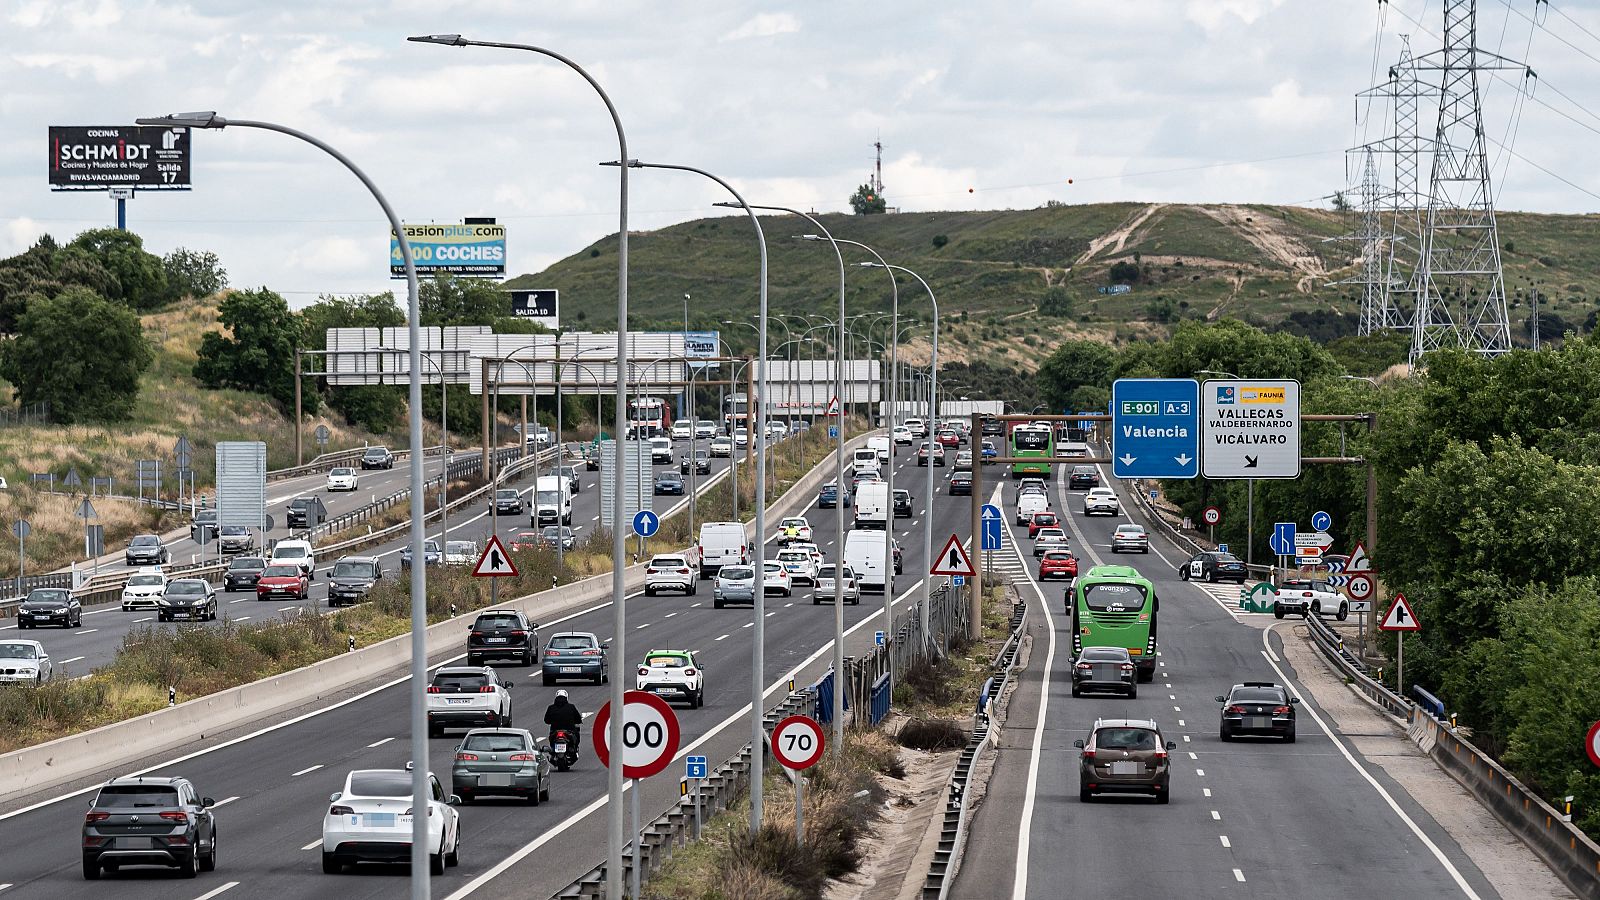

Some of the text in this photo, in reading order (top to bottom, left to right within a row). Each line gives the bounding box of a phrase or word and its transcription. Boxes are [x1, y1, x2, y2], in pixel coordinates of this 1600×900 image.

[87, 129, 119, 138] COCINAS
[61, 161, 85, 169] Cocinas
[93, 161, 118, 169] Muebles
[120, 161, 127, 169] de
[129, 161, 149, 170] Hogar
[157, 164, 182, 172] Salida
[161, 172, 177, 183] 17
[392, 246, 503, 261] 400 COCHES
[1123, 403, 1189, 414] E-901 A-3
[1217, 409, 1284, 419] VALLECAS
[1209, 420, 1293, 428] VALDEBERNARDO
[1123, 425, 1188, 438] Valencia
[1025, 435, 1040, 443] alsa
[1215, 431, 1287, 445] VICÁLVARO
[1351, 582, 1368, 592] 40
[622, 721, 663, 749] 00
[784, 734, 812, 751] 70
[693, 766, 700, 775] 5
